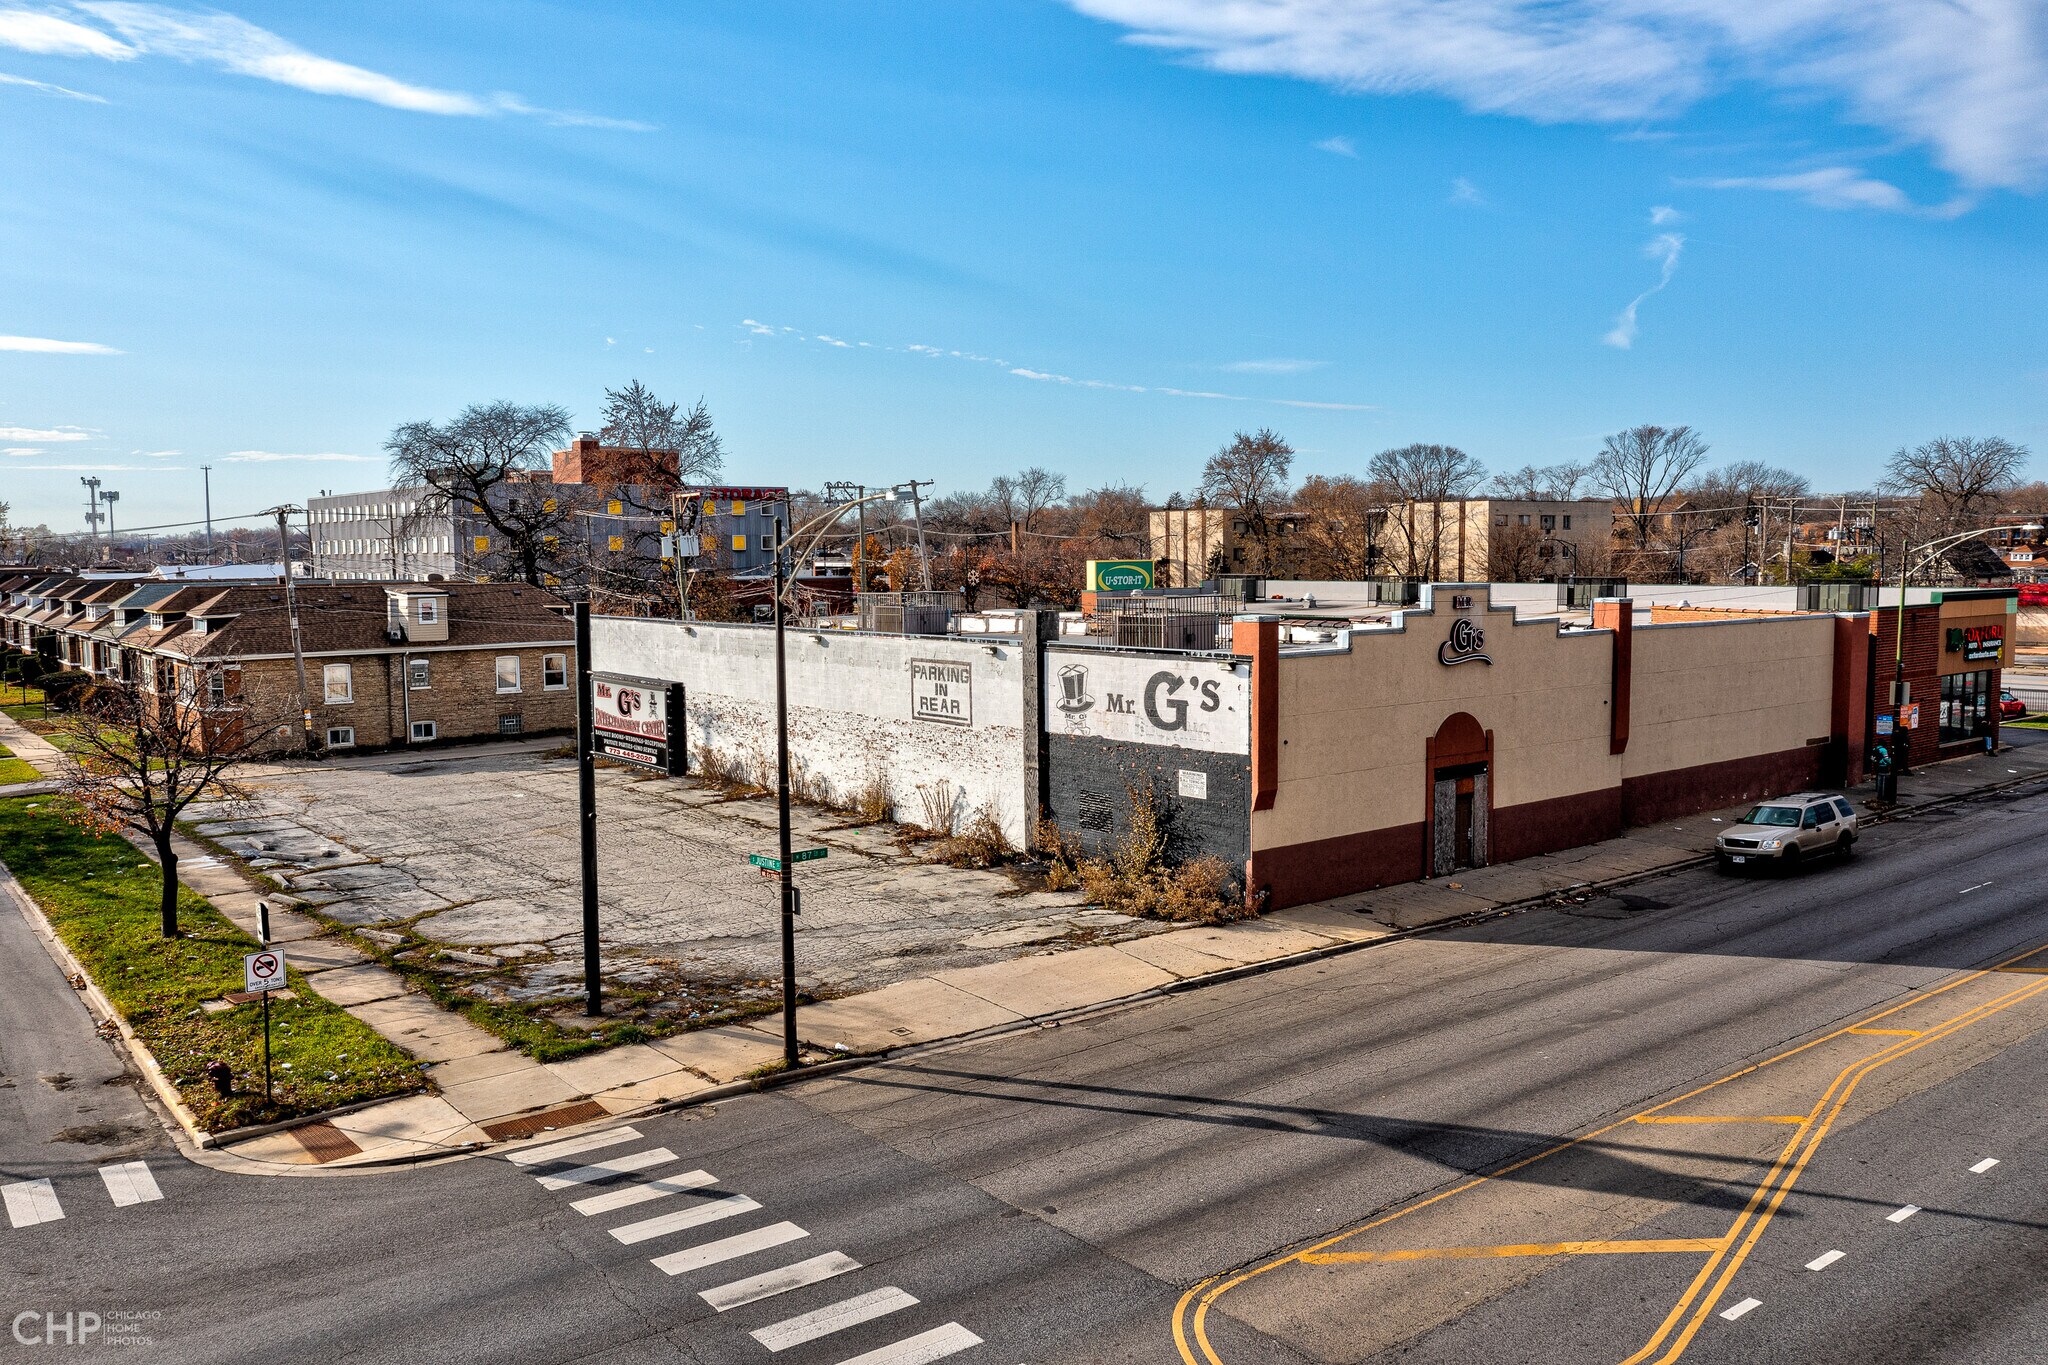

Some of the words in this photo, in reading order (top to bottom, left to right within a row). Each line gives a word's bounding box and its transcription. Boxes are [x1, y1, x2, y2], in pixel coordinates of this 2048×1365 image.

[1105, 575, 1143, 586] U-STOR-IT
[913, 664, 969, 684] PARKING
[596, 683, 612, 699] Mr.
[934, 682, 948, 697] IN
[920, 696, 960, 715] REAR
[1106, 692, 1136, 715] Mr.
[594, 707, 640, 733] ENTERTAINMENT
[641, 719, 666, 738] CENTER
[608, 747, 621, 755] 773
[622, 750, 653, 763] 445-2020
[756, 857, 776, 868] JUSTINE
[263, 978, 270, 988] 5
